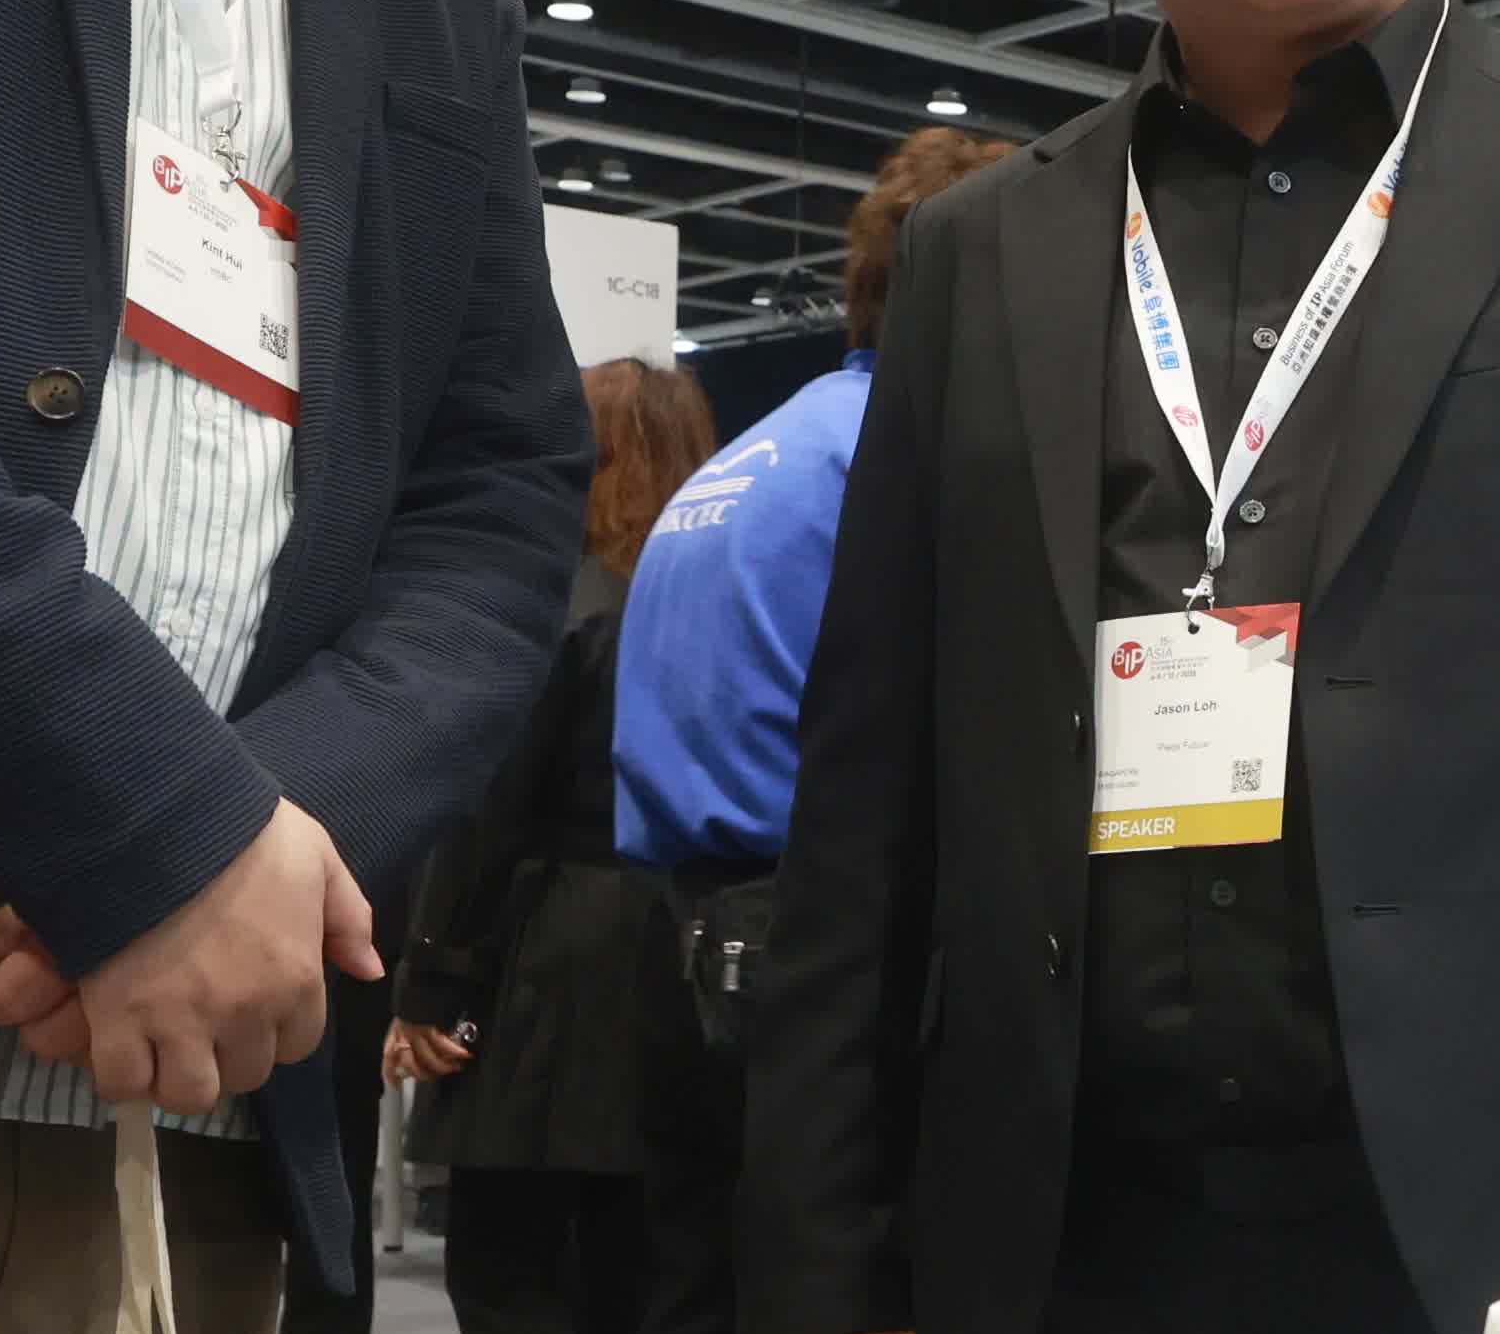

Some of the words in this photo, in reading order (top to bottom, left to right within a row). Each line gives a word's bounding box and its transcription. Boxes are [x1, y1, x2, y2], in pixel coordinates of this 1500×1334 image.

[1310, 290, 1324, 308] IP
[1154, 702, 1191, 716] Jason
[1193, 699, 1218, 713] Loh
[1097, 816, 1175, 841] SPEAKER
